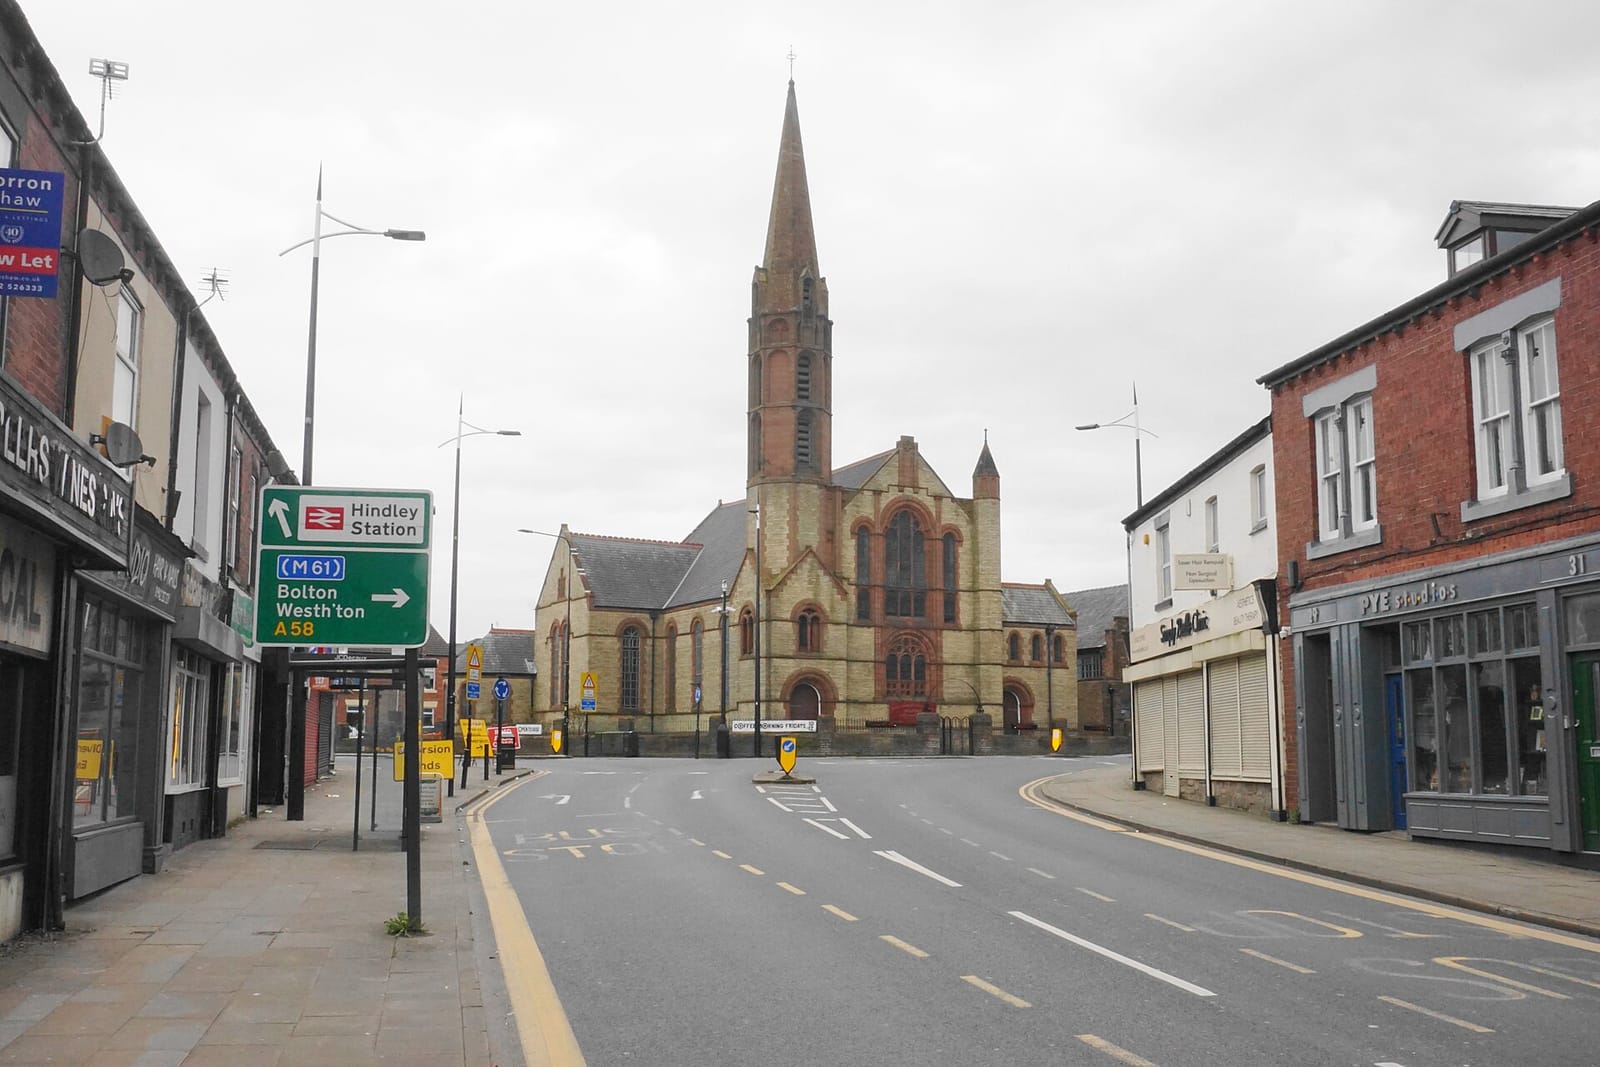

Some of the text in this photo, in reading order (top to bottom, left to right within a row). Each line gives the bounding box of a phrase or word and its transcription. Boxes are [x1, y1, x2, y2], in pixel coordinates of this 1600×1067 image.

[1, 190, 41, 207] haw
[21, 253, 52, 268] Let
[7, 283, 43, 292] 526333
[351, 503, 418, 521] Hindley
[351, 521, 416, 536] Station
[1569, 553, 1584, 576] 31
[277, 584, 337, 599] Bolton
[276, 602, 365, 618] Westh'ton
[1361, 592, 1390, 615] PYE
